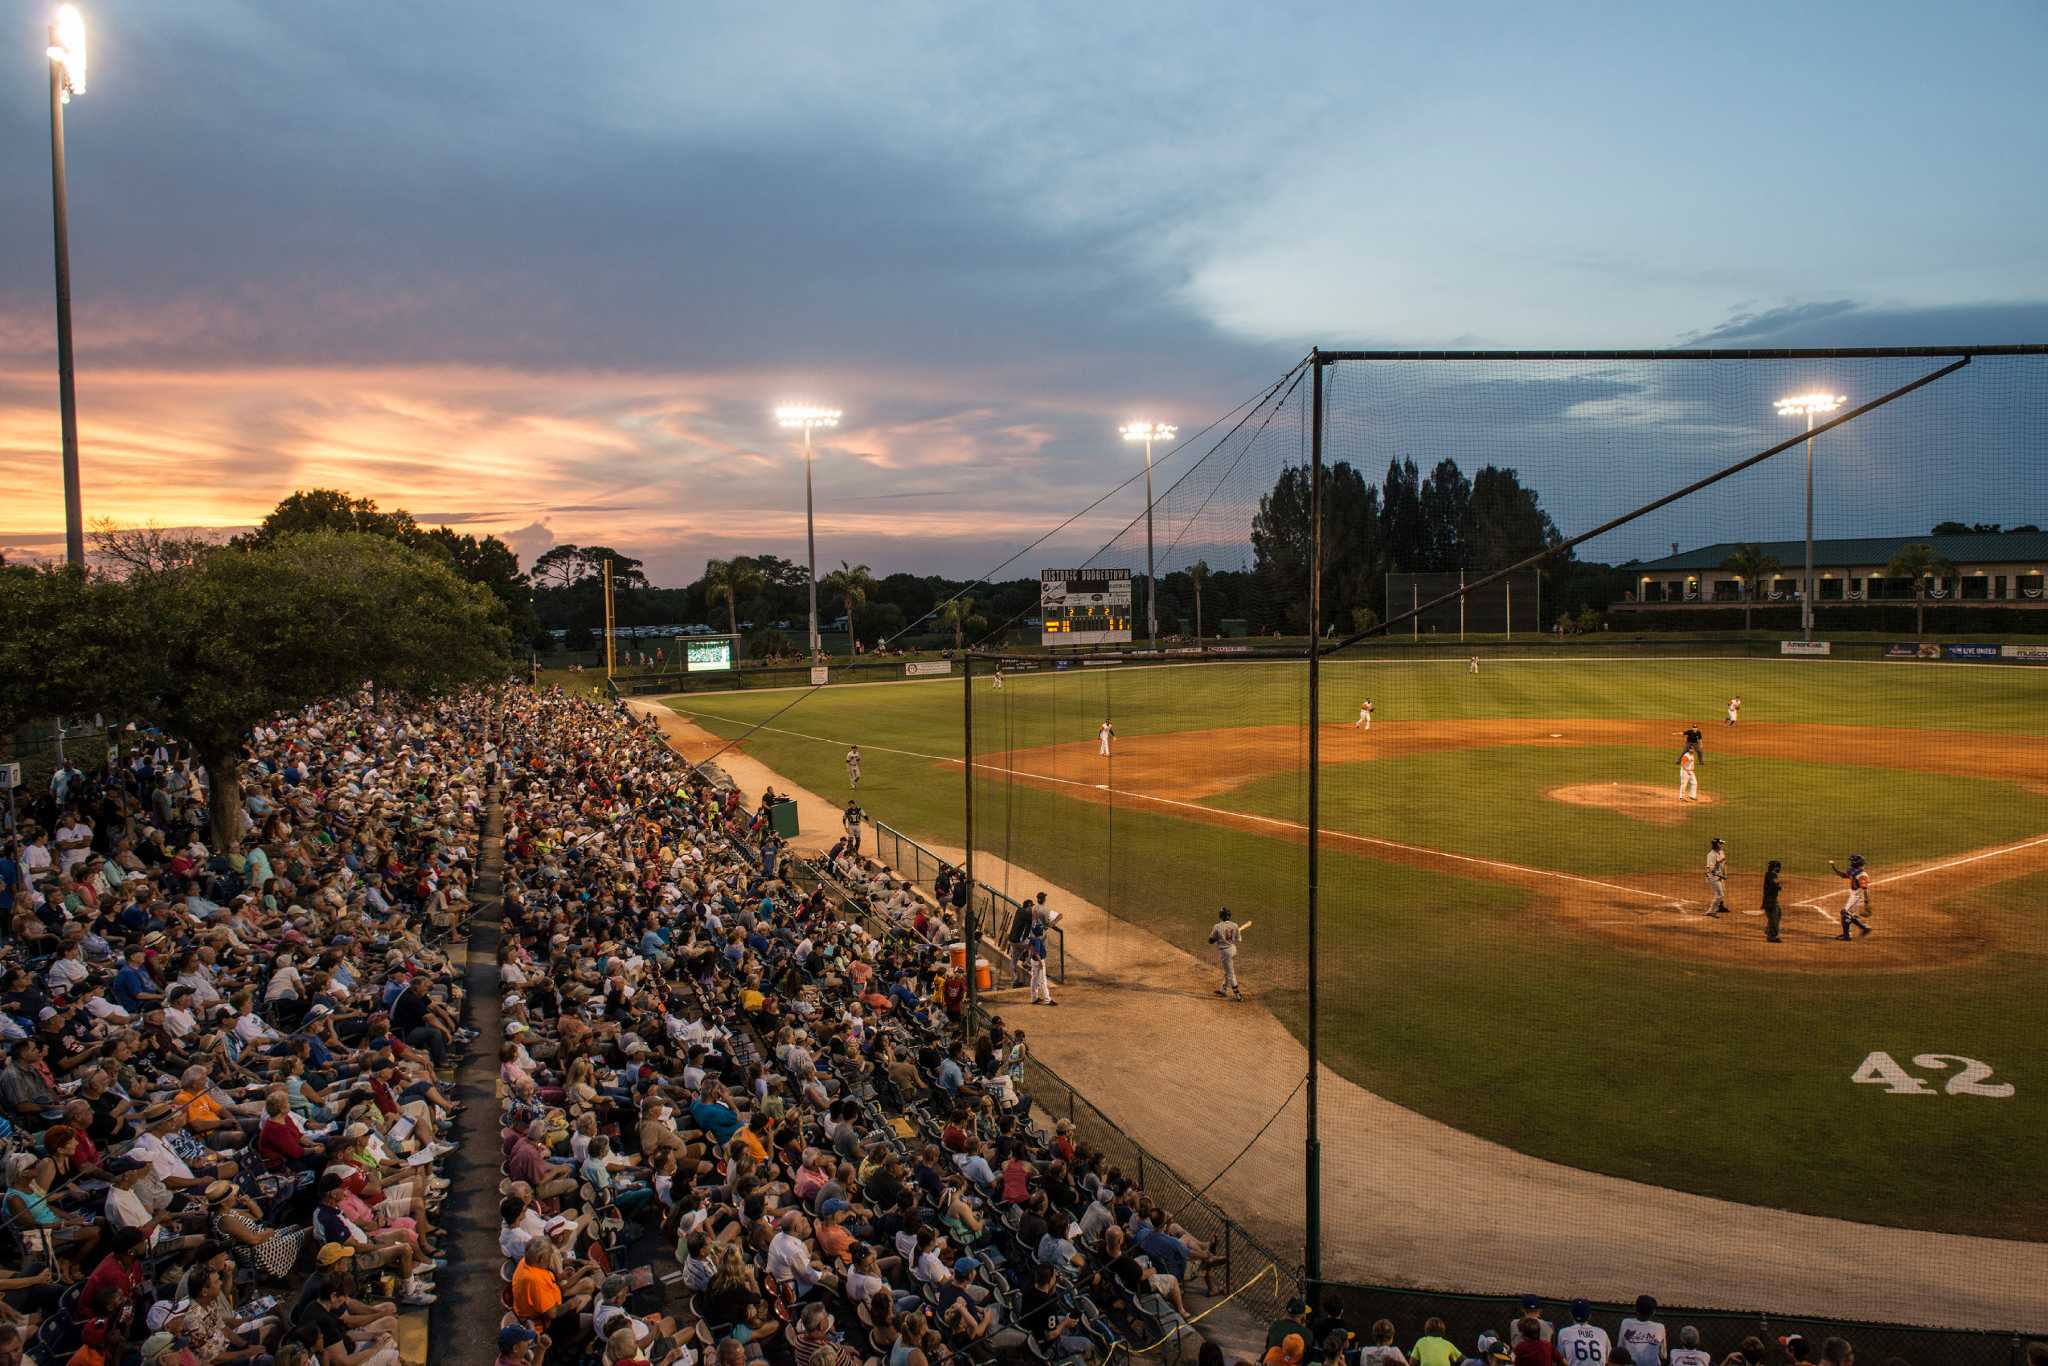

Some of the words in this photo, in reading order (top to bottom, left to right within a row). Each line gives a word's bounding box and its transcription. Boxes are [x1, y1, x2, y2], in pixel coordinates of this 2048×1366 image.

[1043, 570, 1077, 580] HISTORIC
[1081, 570, 1130, 580] DODGERTOWN
[1850, 1051, 2015, 1098] 42
[1048, 1315, 1056, 1329] 8
[1575, 1340, 1601, 1361] 66
